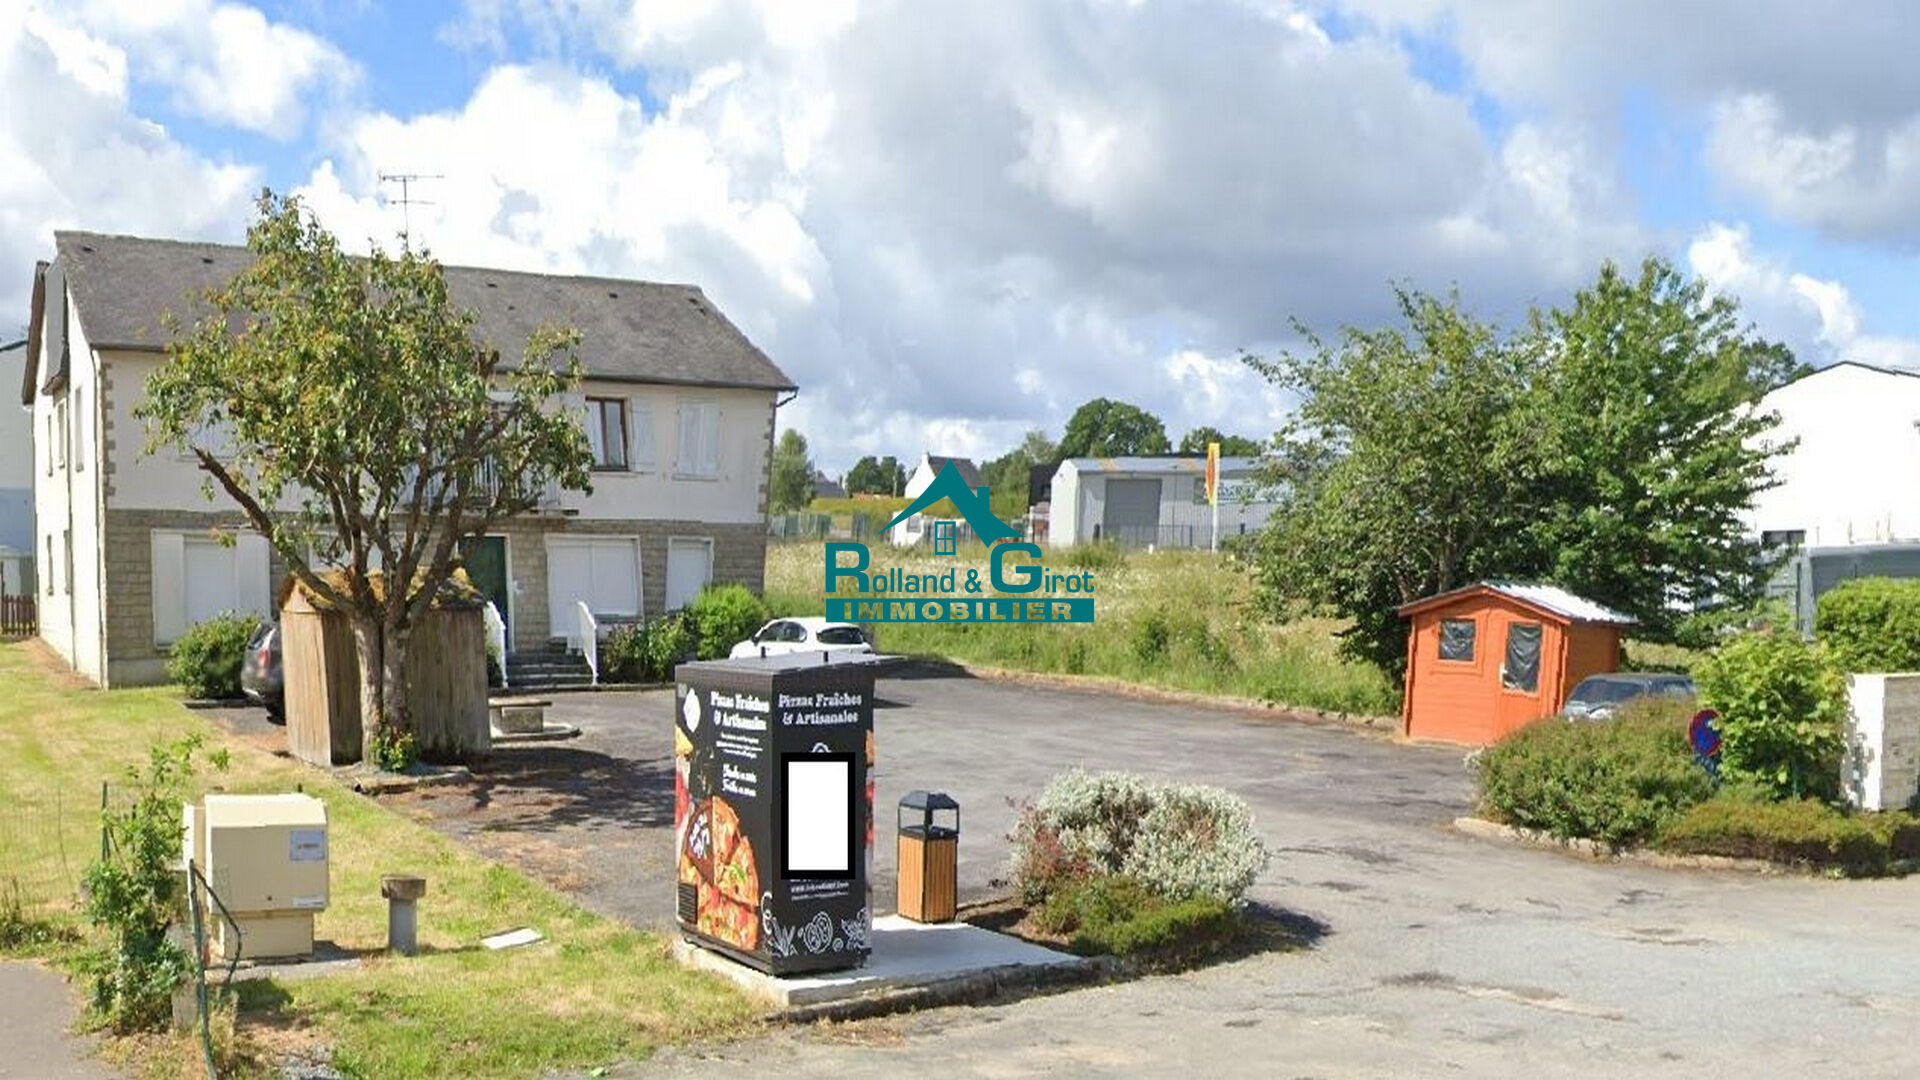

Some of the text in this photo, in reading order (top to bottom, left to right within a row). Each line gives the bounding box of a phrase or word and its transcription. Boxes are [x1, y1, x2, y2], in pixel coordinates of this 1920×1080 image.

[778, 692, 862, 708] Pizzas Fraîches
[796, 710, 858, 725] Artisanales
